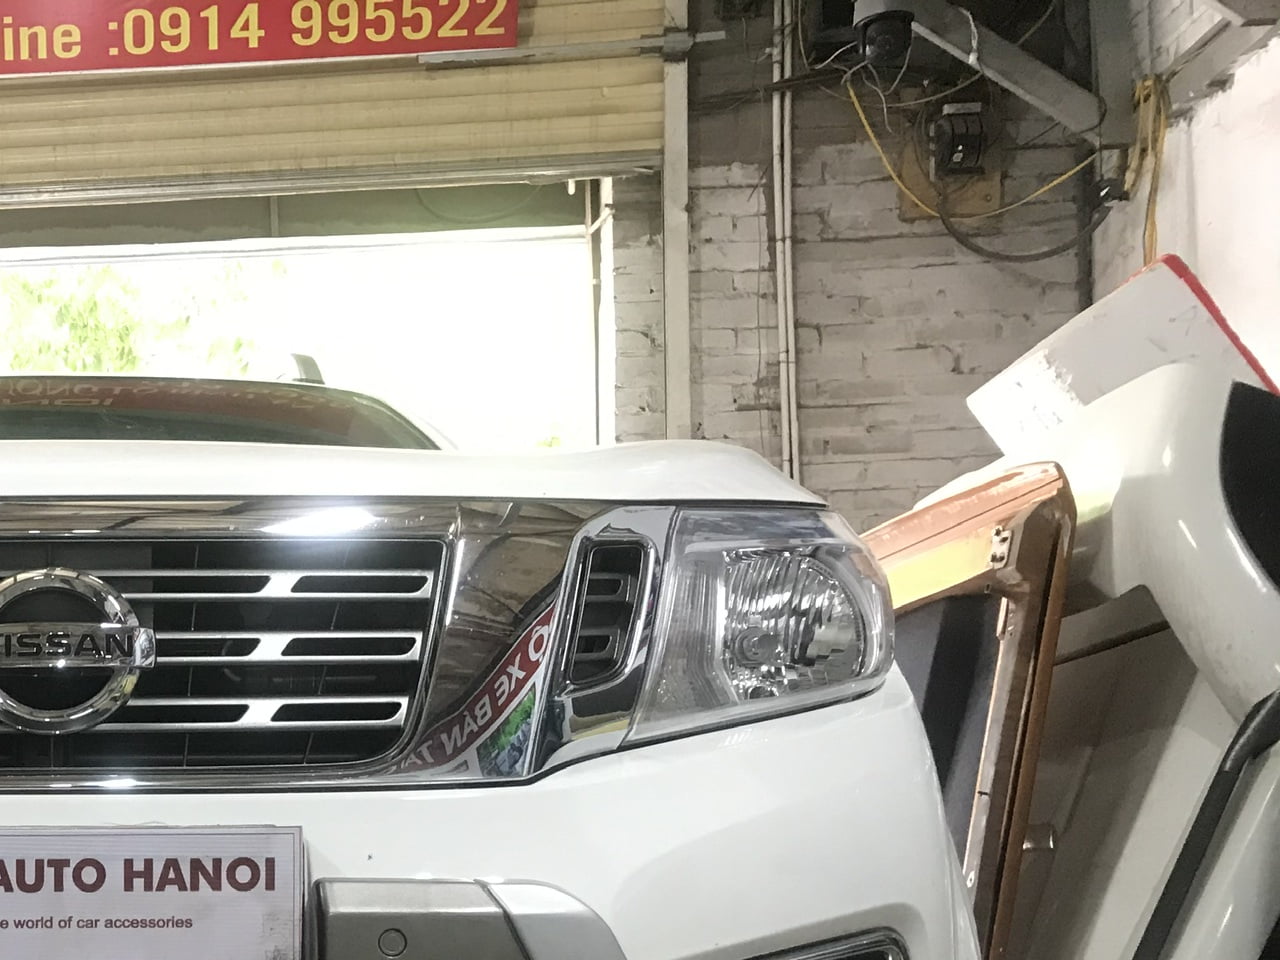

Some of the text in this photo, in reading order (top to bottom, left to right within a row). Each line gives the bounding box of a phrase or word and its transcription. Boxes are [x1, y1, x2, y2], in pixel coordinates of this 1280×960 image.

[291, 0, 506, 46] 995522
[123, 856, 276, 893] HANOI
[13, 915, 54, 930] world
[58, 915, 74, 930] of
[76, 918, 101, 930] car
[104, 915, 194, 930] accessories
